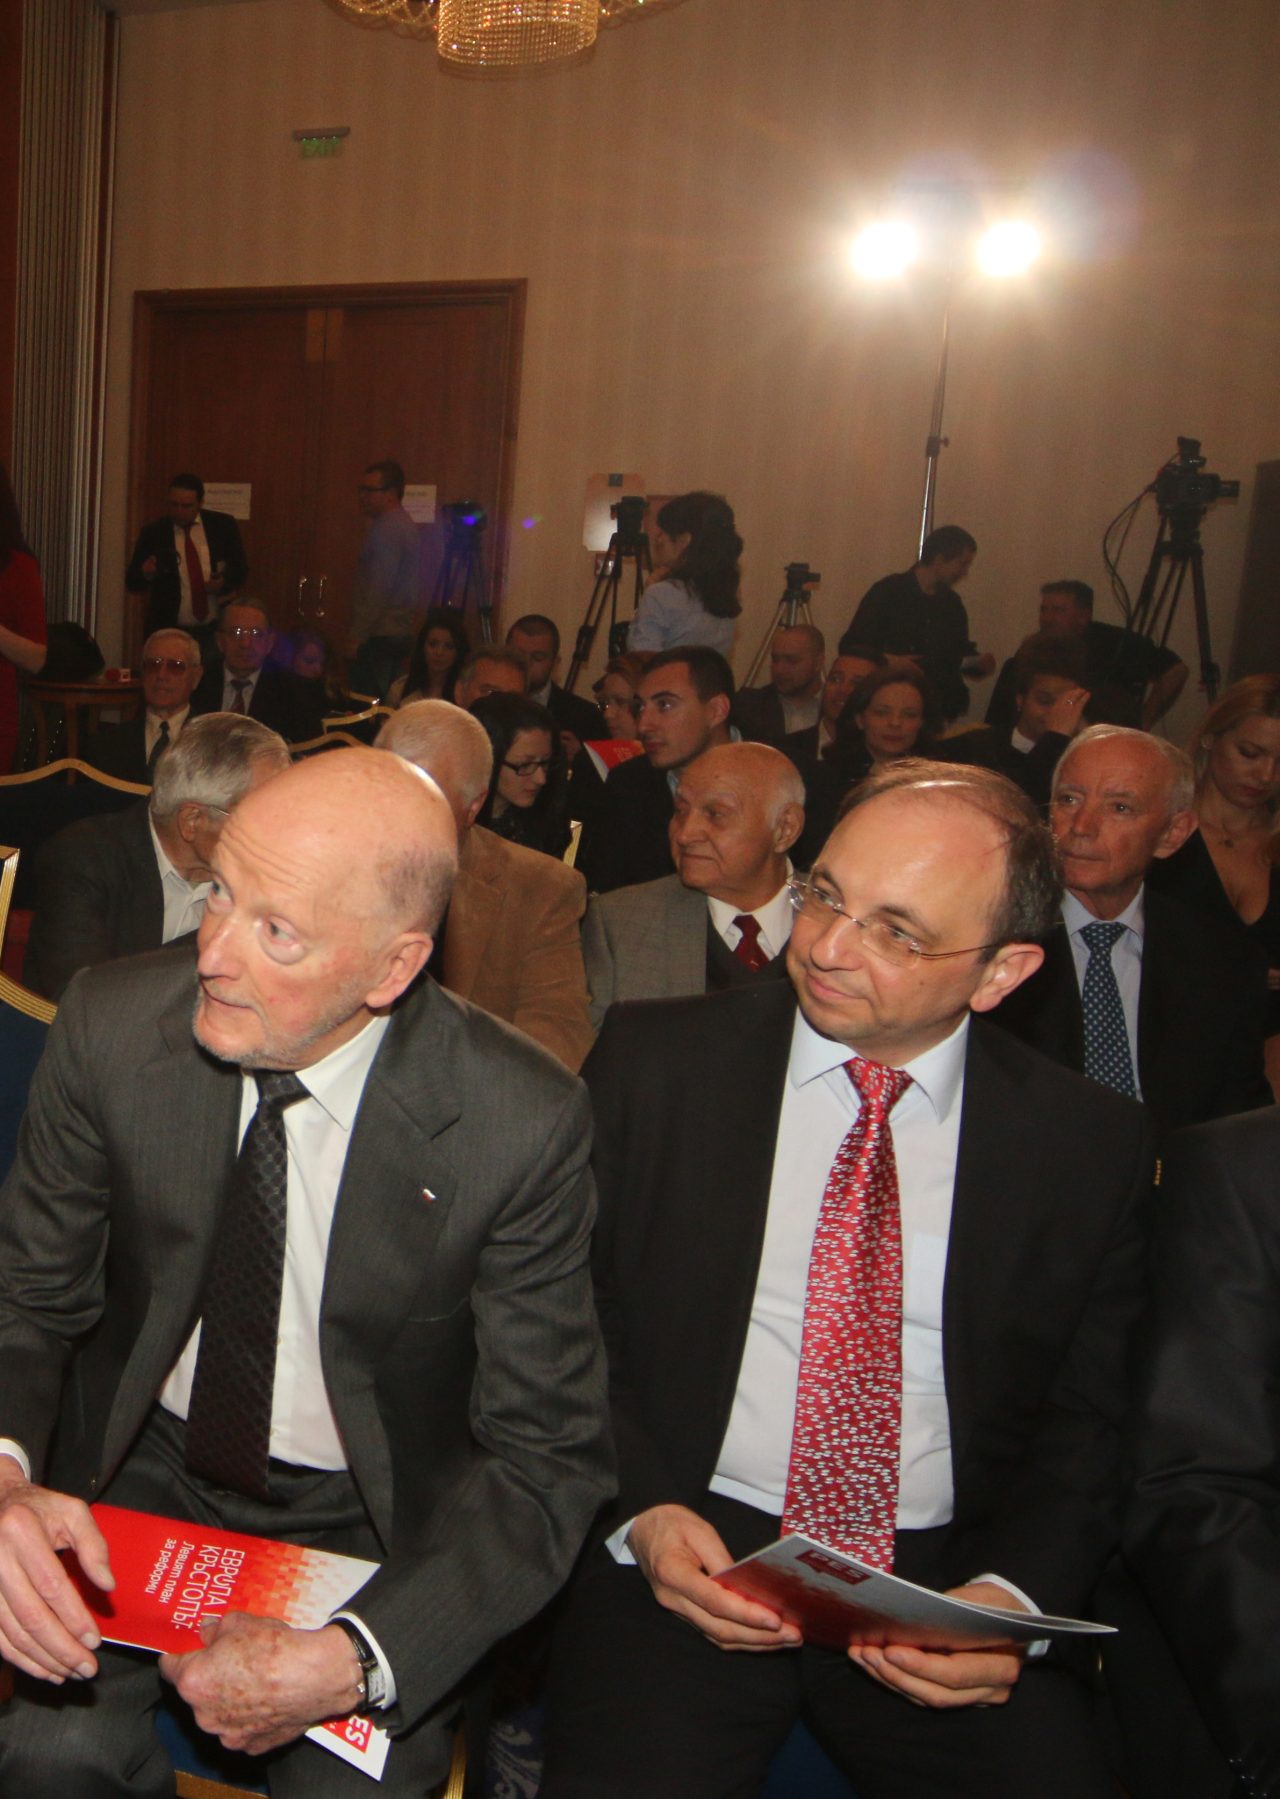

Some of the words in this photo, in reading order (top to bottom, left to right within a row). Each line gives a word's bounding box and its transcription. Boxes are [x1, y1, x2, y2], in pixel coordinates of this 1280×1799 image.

[165, 1538, 177, 1549] за
[809, 1552, 864, 1578] PES
[345, 1715, 369, 1746] ES
